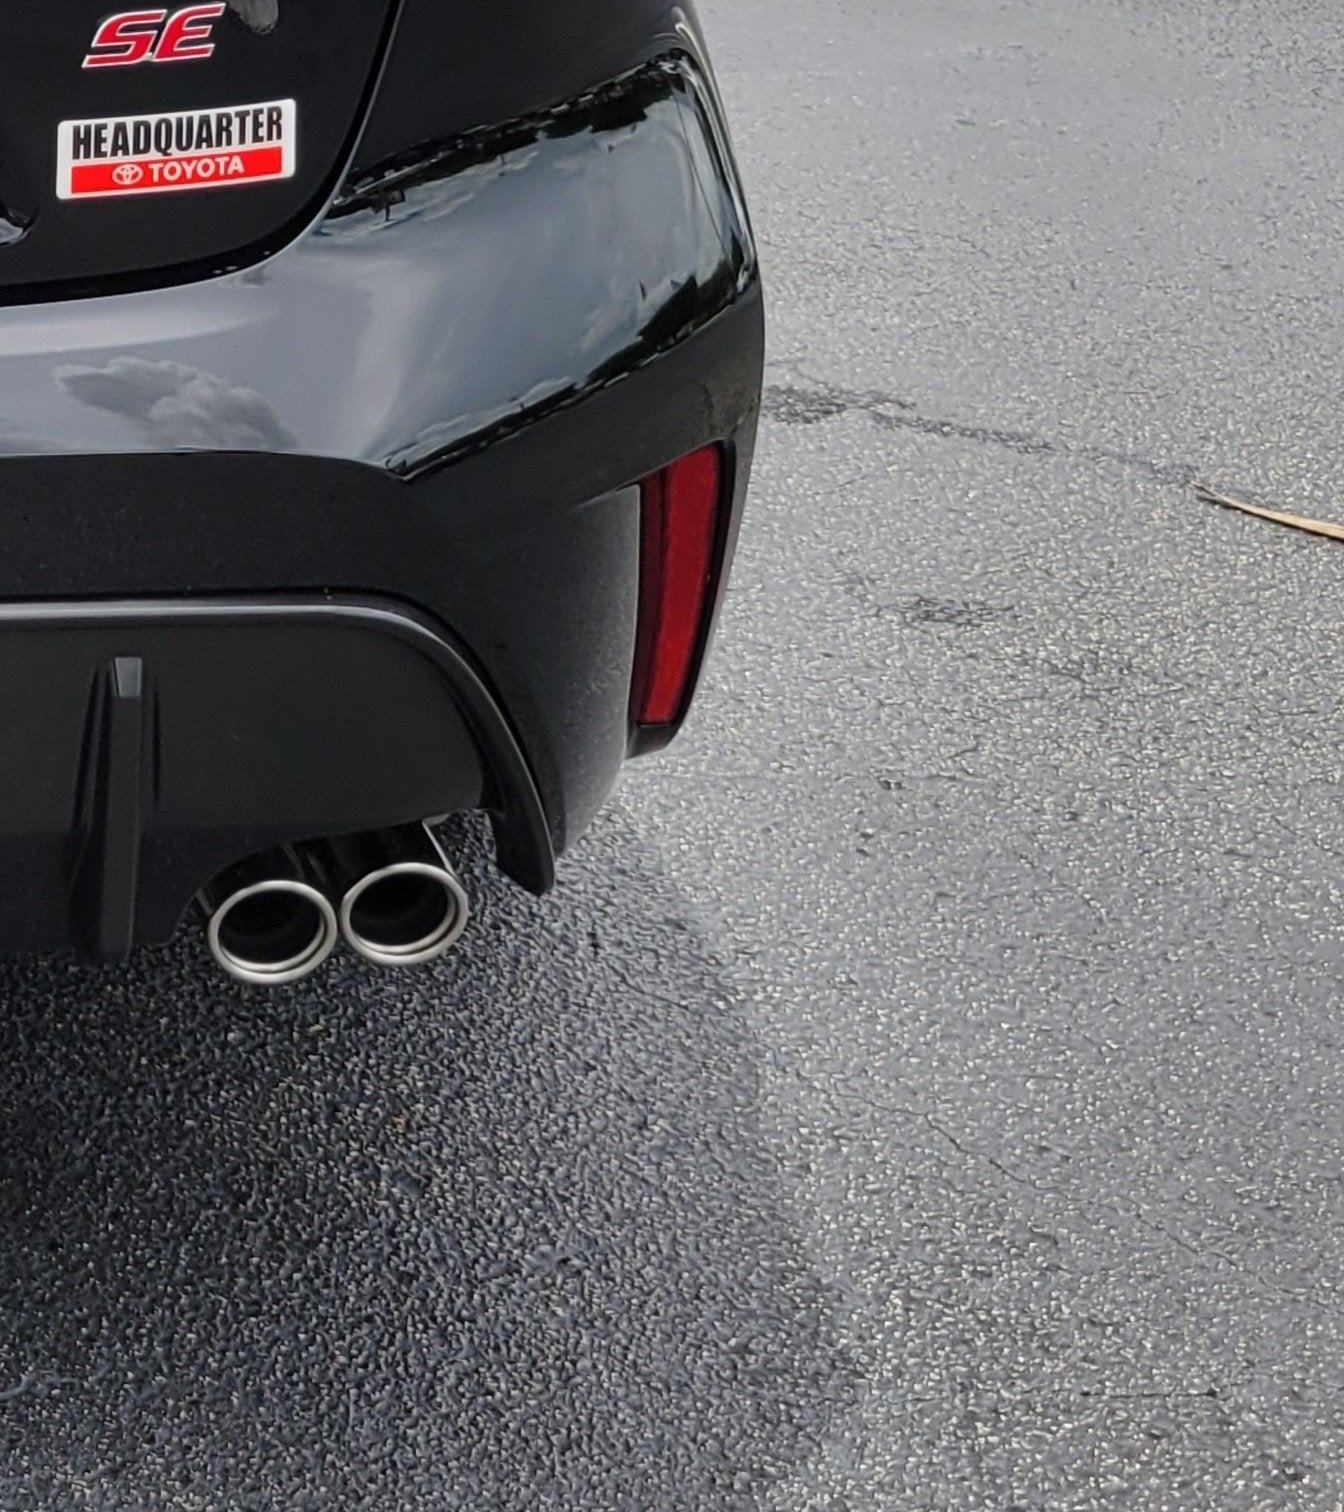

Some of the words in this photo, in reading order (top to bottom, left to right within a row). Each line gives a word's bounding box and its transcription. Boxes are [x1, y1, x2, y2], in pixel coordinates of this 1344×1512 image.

[81, 1, 227, 70] SE
[71, 105, 284, 161] HEADQUARTER
[148, 155, 246, 184] TOYOTA
